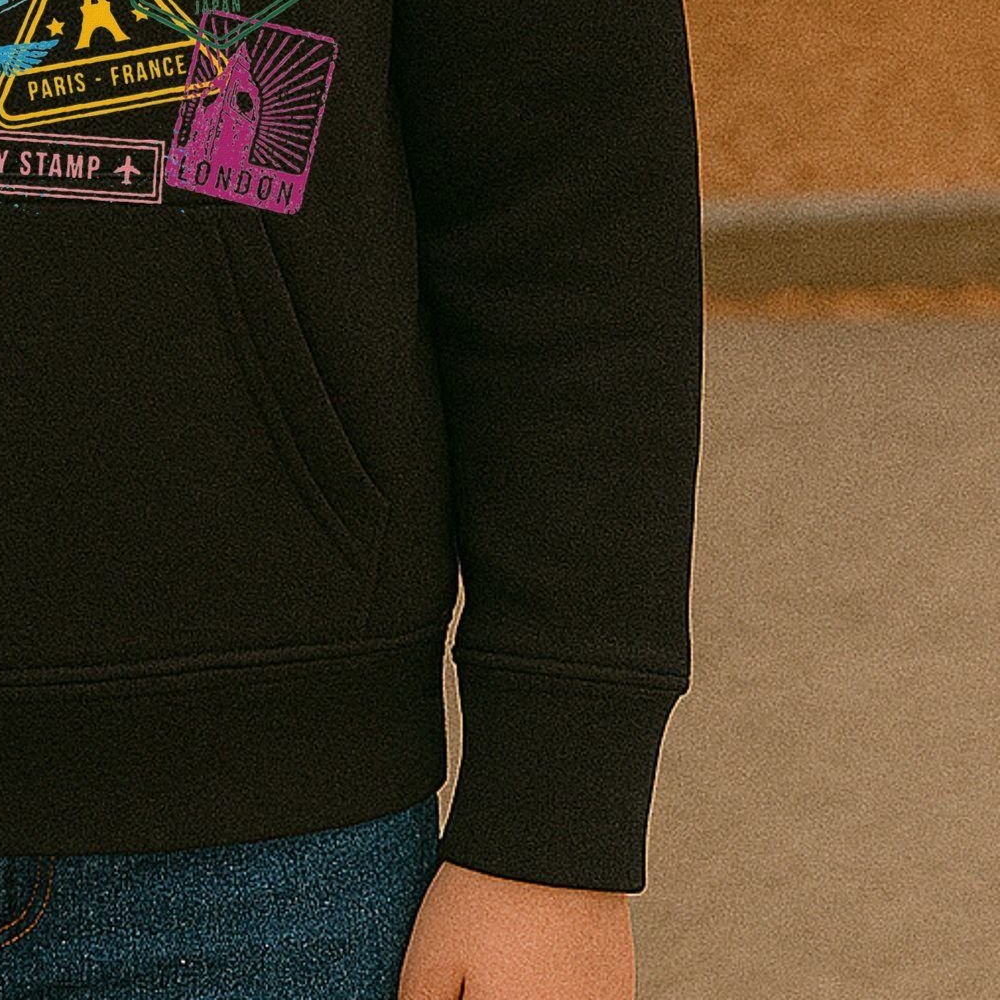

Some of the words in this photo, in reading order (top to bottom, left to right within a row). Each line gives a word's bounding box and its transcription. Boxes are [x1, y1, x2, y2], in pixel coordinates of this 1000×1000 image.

[28, 72, 87, 102] PARIS
[110, 54, 188, 87] FRANCE
[19, 150, 101, 180] STAMP
[177, 155, 295, 207] LONDON
